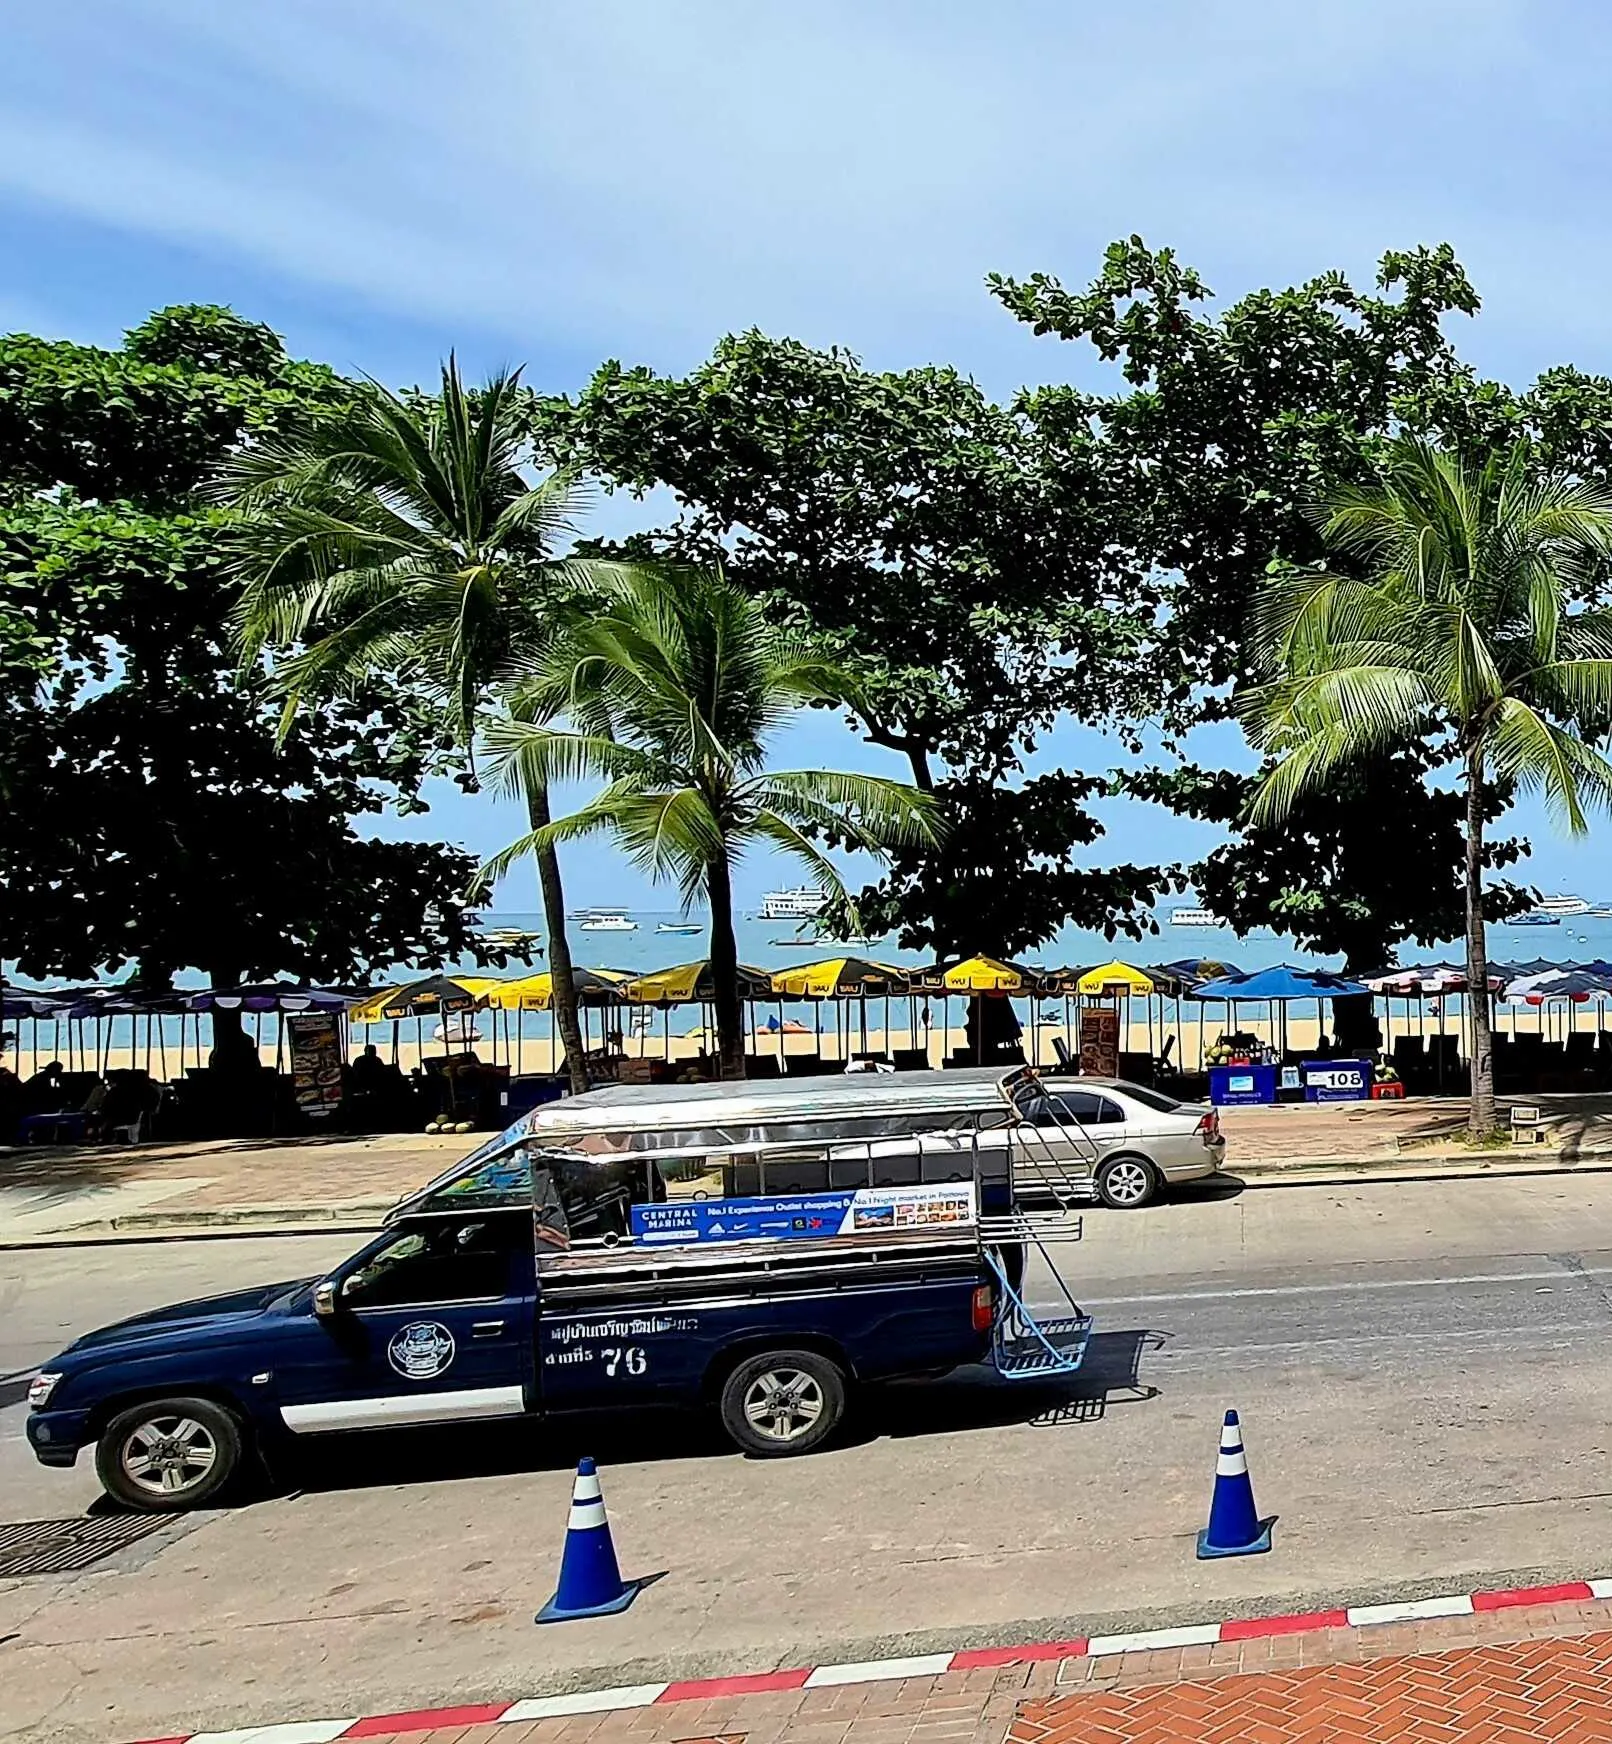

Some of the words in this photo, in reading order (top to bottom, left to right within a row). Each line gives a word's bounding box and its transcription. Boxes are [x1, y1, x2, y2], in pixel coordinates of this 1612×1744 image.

[1327, 1072, 1362, 1086] 108
[803, 1199, 843, 1211] shopping
[641, 1208, 698, 1221] CENTRAL
[648, 1218, 692, 1229] MARINA
[600, 1347, 648, 1377] 76
